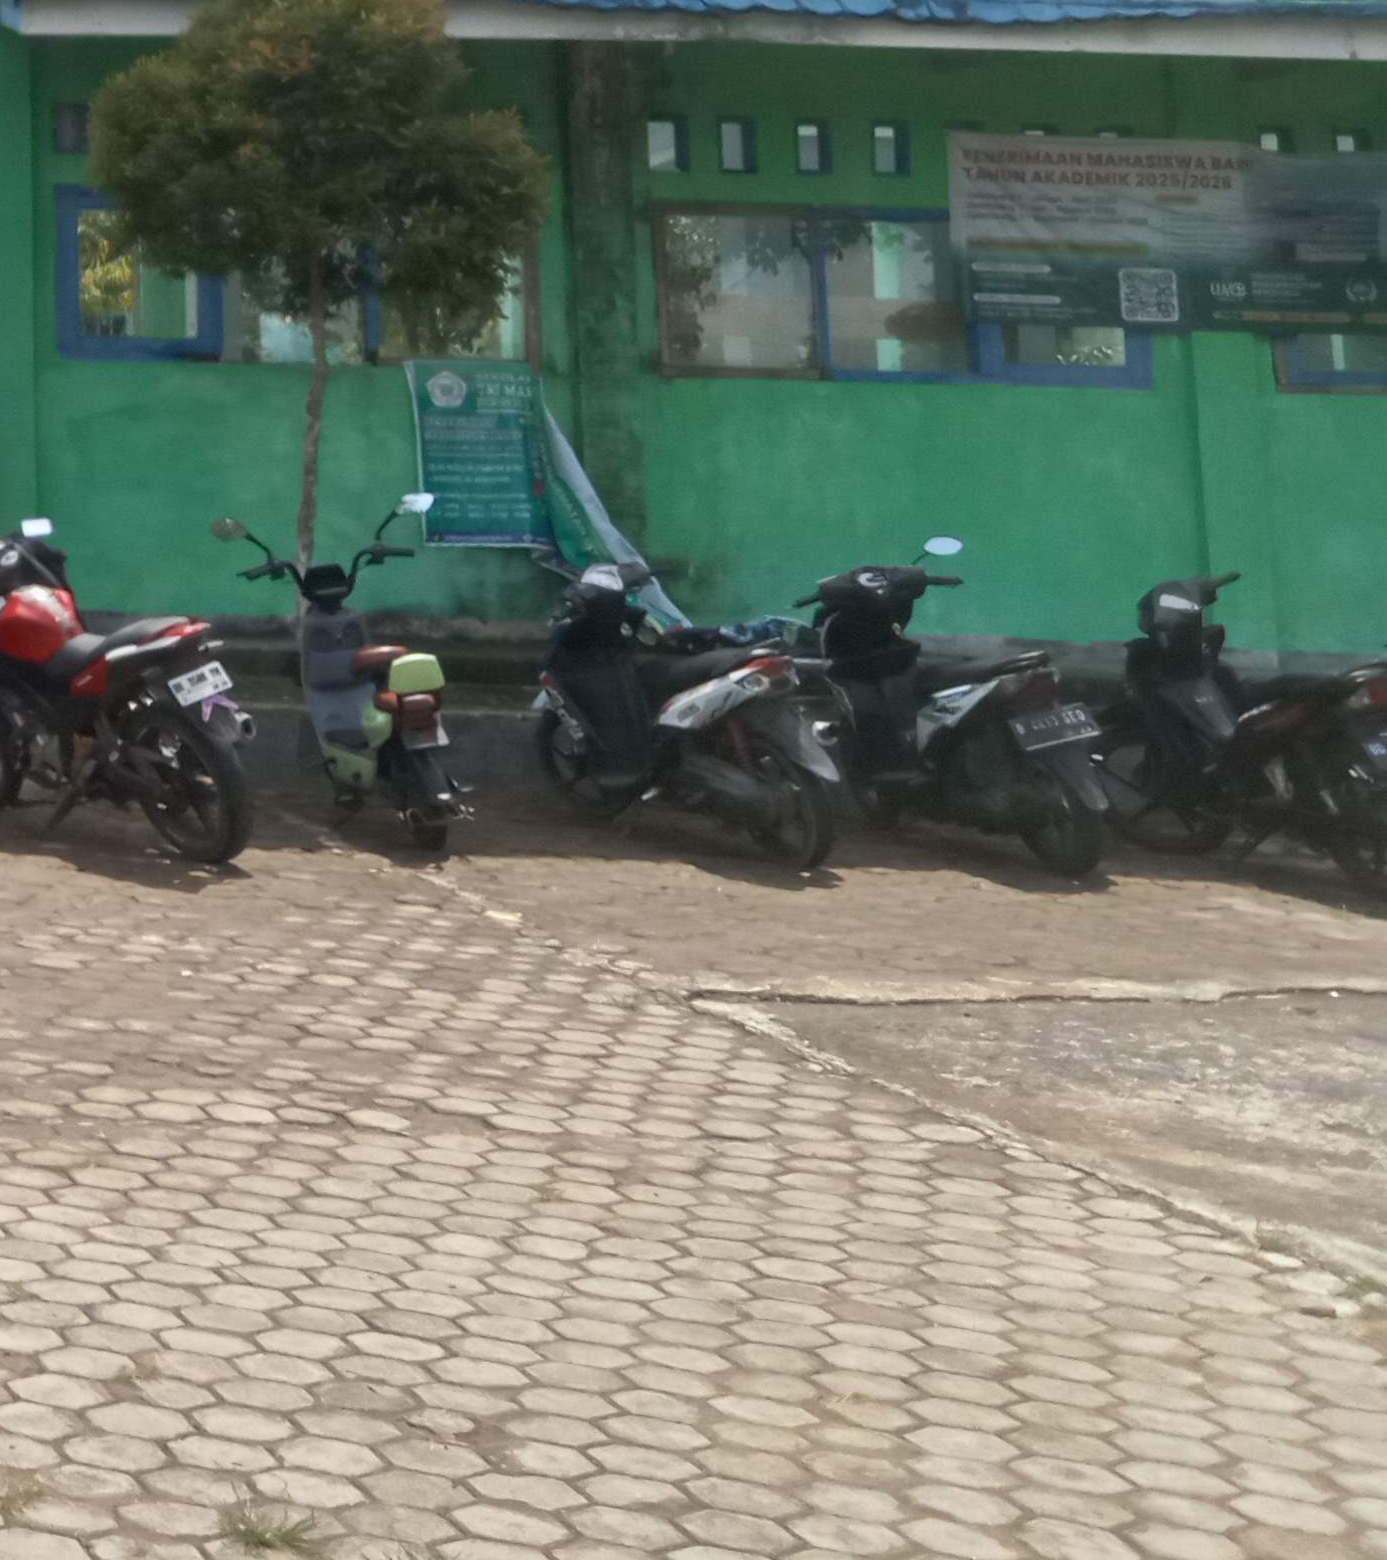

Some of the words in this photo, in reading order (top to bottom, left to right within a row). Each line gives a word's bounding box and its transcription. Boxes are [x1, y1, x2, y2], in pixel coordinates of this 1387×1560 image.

[962, 148, 1082, 166] PENERIMAAN
[1086, 151, 1206, 169] MAHASISWA
[962, 166, 1026, 183] TAHUN
[1031, 170, 1130, 186] AKADEMIK
[1135, 172, 1231, 189] 2025/2026
